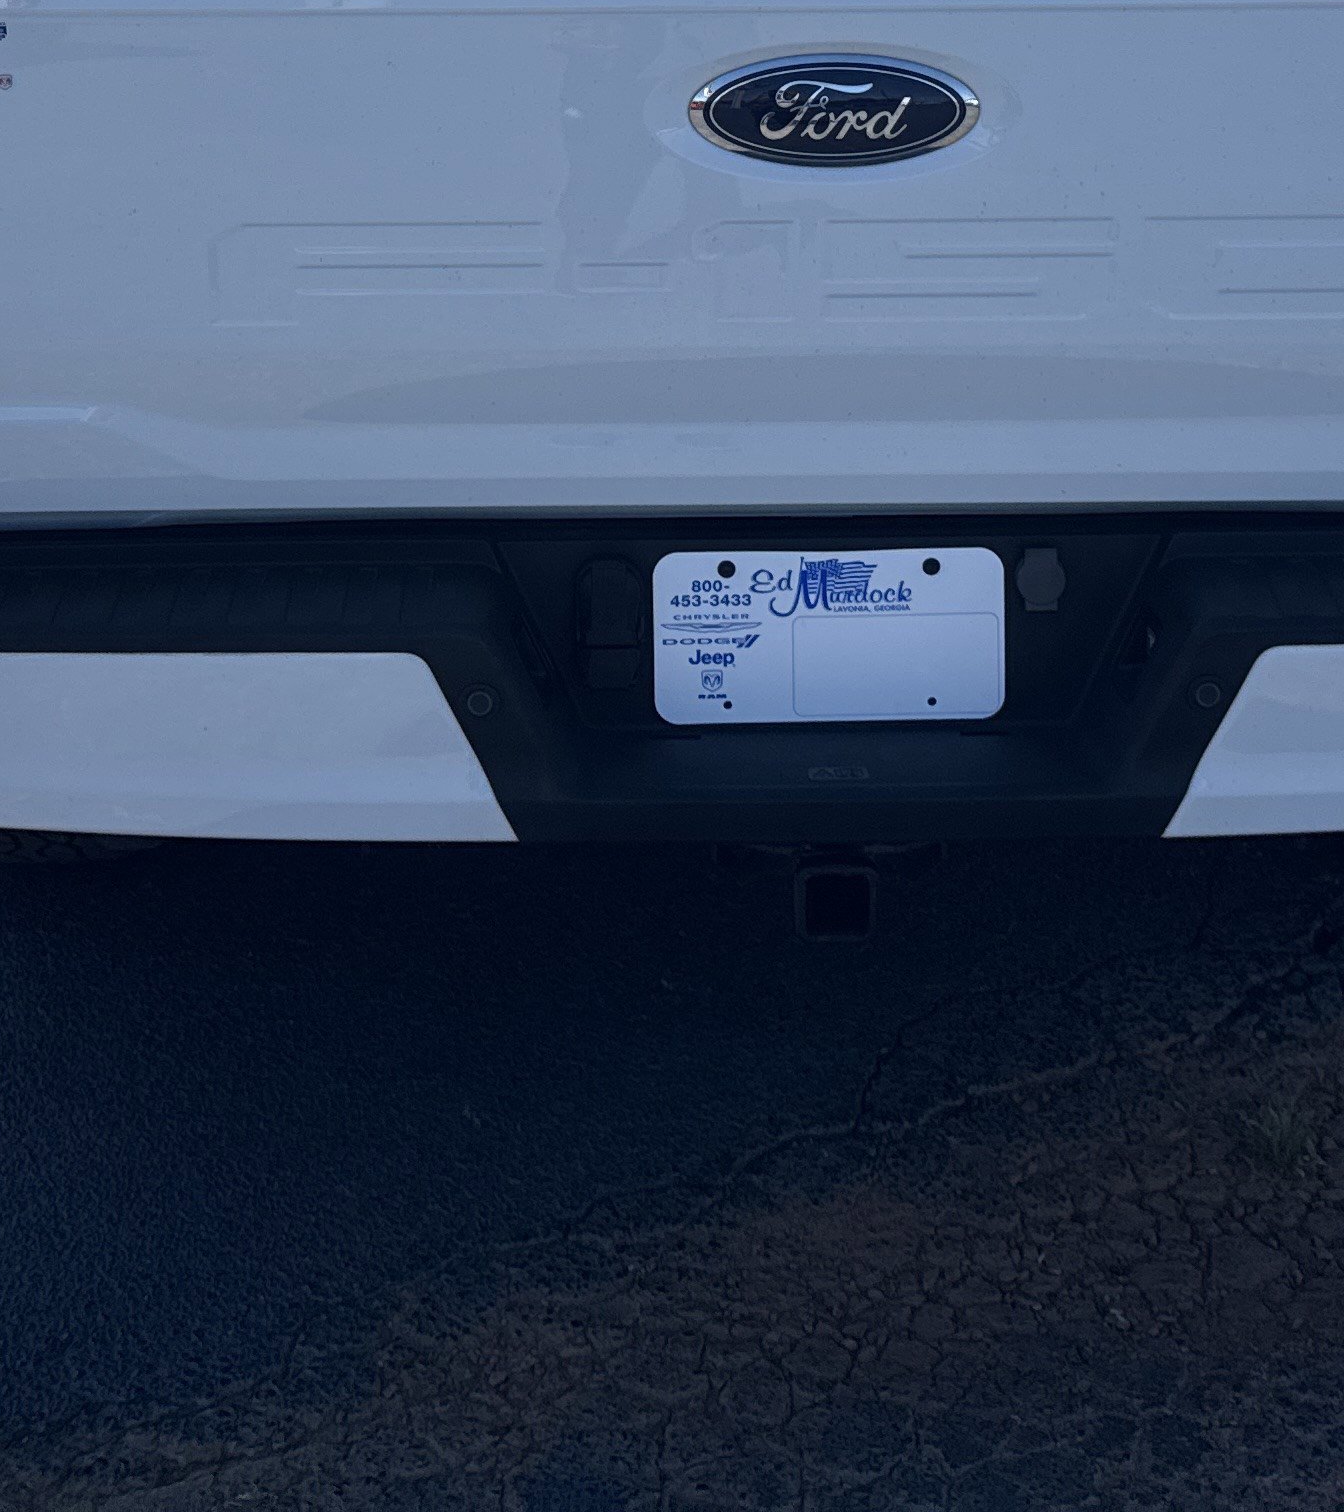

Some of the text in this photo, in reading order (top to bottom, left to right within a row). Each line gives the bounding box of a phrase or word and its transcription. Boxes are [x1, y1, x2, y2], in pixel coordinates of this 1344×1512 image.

[759, 80, 911, 141] Ford
[691, 579, 730, 593] 800-
[749, 556, 912, 618] Ed Murdock
[670, 593, 752, 607] 453-3433
[833, 603, 911, 613] LAVONIA, GEORGIA
[673, 613, 750, 621] CHRYSLER
[688, 649, 735, 668] Jeep
